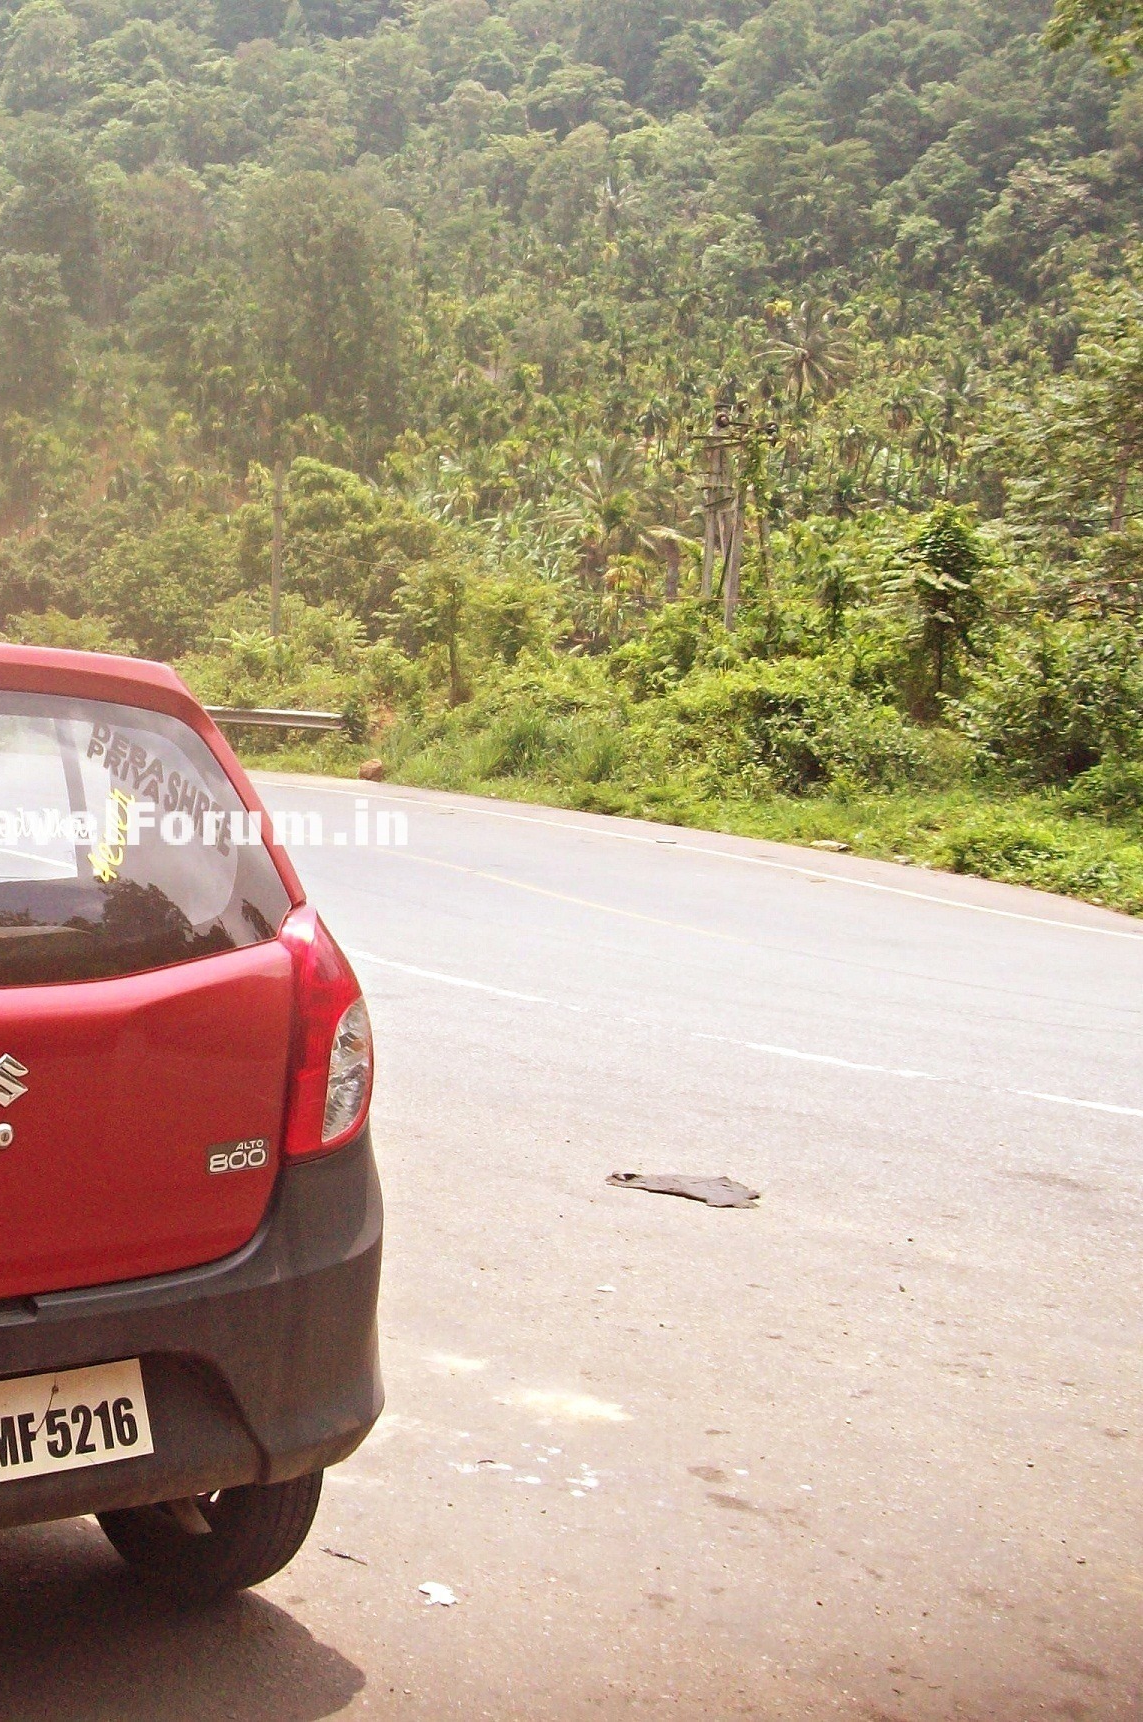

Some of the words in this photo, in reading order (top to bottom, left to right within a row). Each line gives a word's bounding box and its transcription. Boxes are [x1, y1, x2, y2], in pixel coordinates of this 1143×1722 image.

[87, 738, 160, 804] PRIYA
[209, 1148, 266, 1173] 800
[236, 1139, 264, 1151] ALTO
[45, 1397, 139, 1459] 5216
